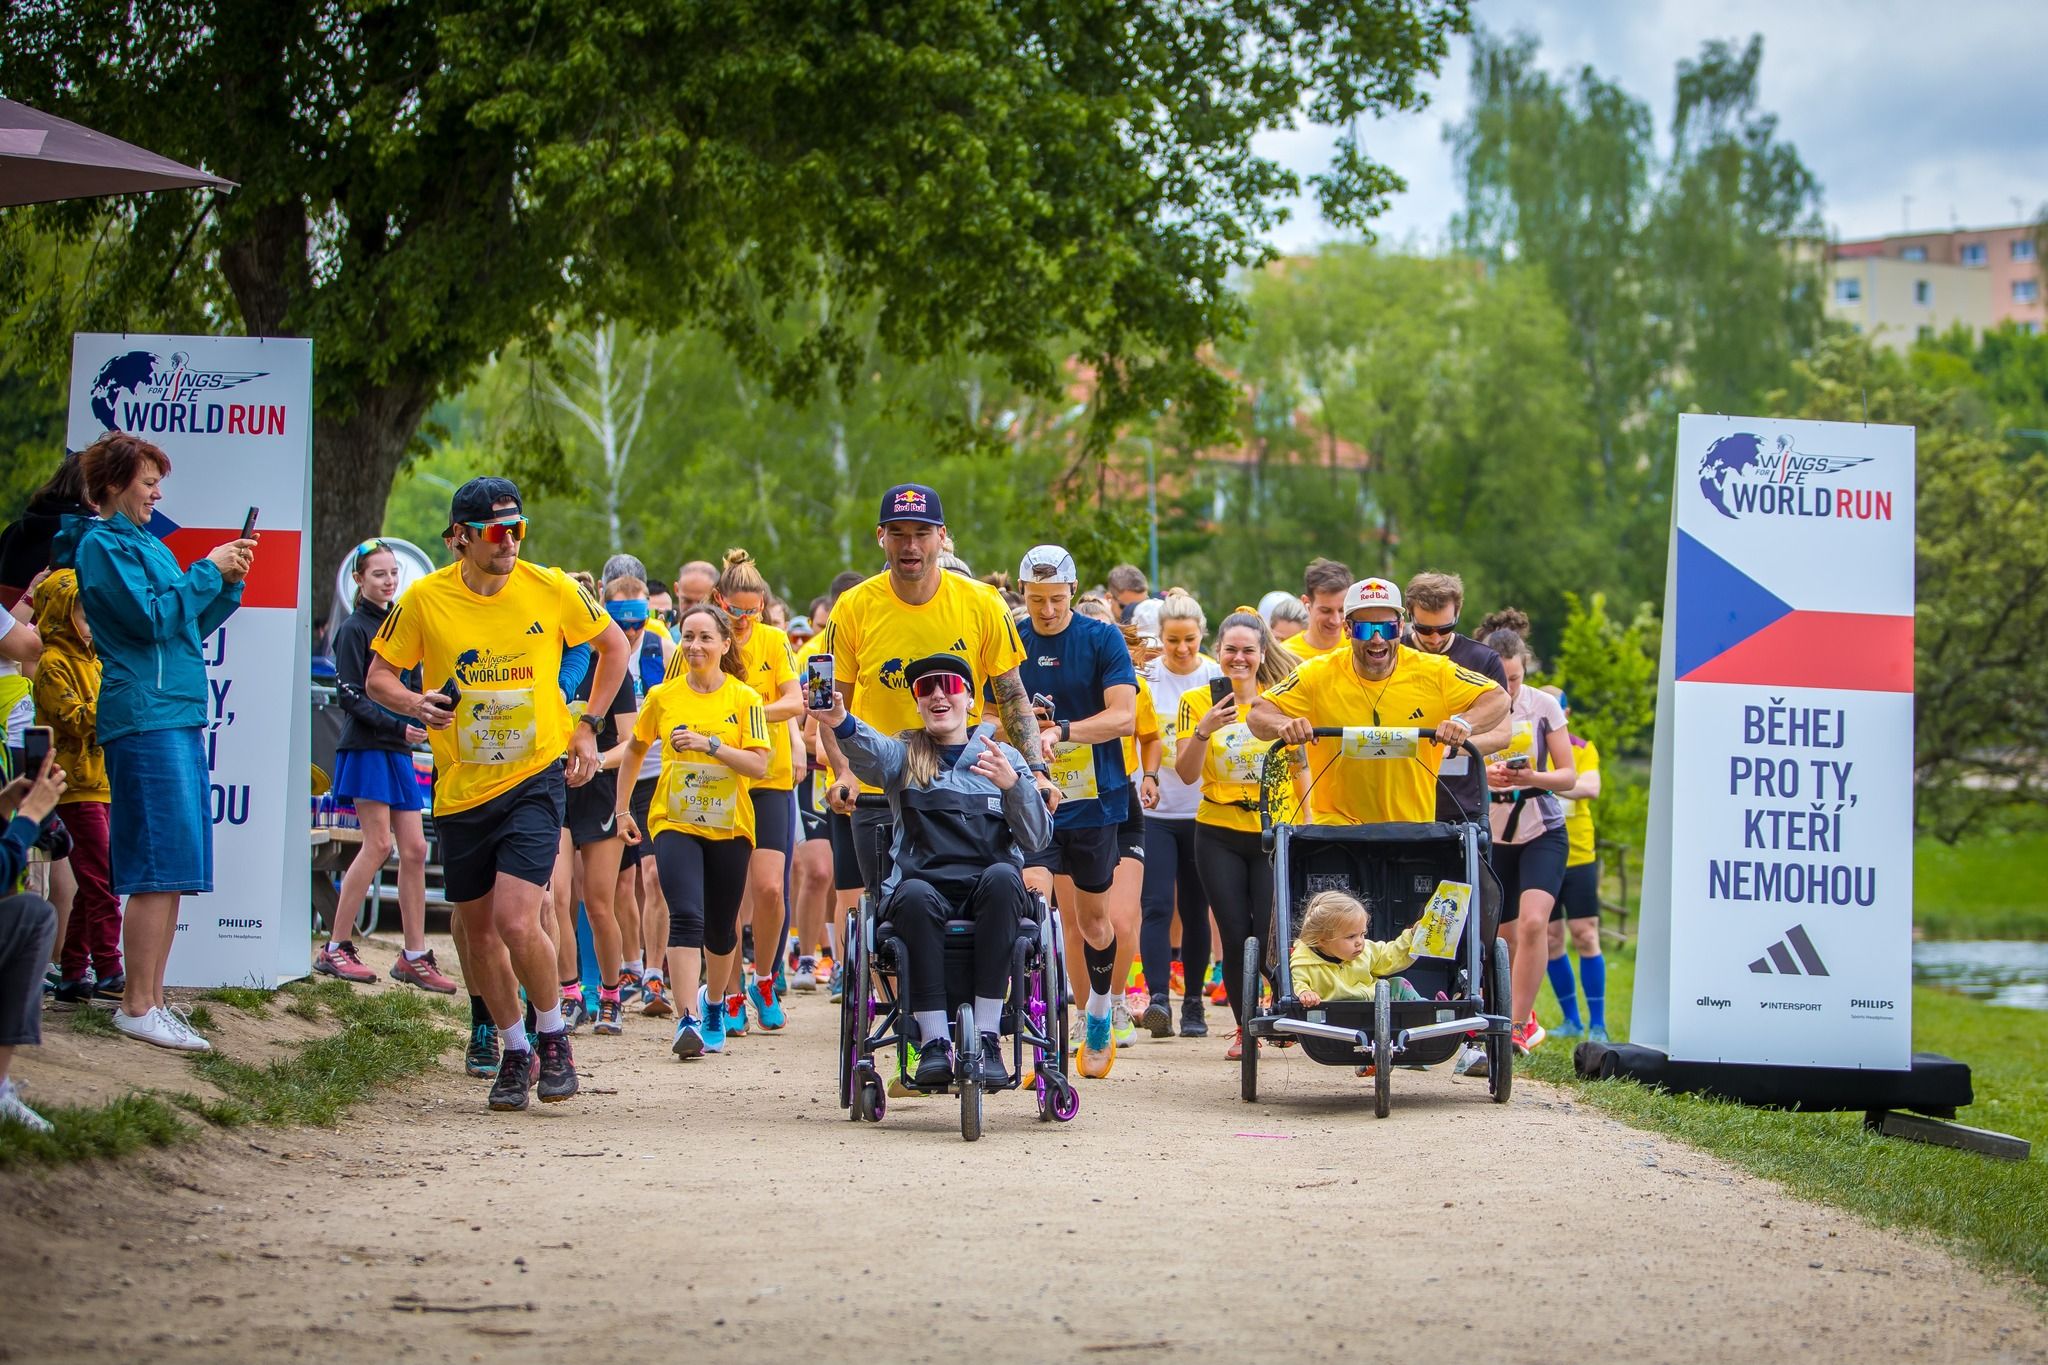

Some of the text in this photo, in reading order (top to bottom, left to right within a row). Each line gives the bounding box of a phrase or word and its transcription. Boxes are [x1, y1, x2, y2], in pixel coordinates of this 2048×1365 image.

[153, 369, 223, 388] WINGS
[147, 387, 202, 402] FOR LIFE
[124, 402, 286, 435] WORLD RUN
[1760, 453, 1829, 472] WINGS
[1755, 468, 1809, 485] FOR LIFE
[894, 502, 926, 513] Red Bull
[1732, 483, 1892, 520] WORLD RUN
[1360, 592, 1389, 601] Red Bull
[469, 666, 533, 683] WORLD RUN
[208, 679, 235, 726] Y,
[1744, 696, 1845, 749] BĚHEJ
[474, 729, 520, 741] 127675
[1361, 729, 1403, 741] 149415
[1052, 770, 1079, 782] 3761
[1730, 756, 1858, 808] PRO TY,
[684, 795, 722, 807] 193814
[1744, 802, 1845, 853] KTEŘÍ
[1709, 859, 1876, 907] NEMOHOU
[218, 918, 263, 928] PHILIPS
[1696, 996, 1732, 1010] allwyn
[1768, 1001, 1823, 1012] INTERSPORT
[1850, 999, 1894, 1010] PHILIPS
